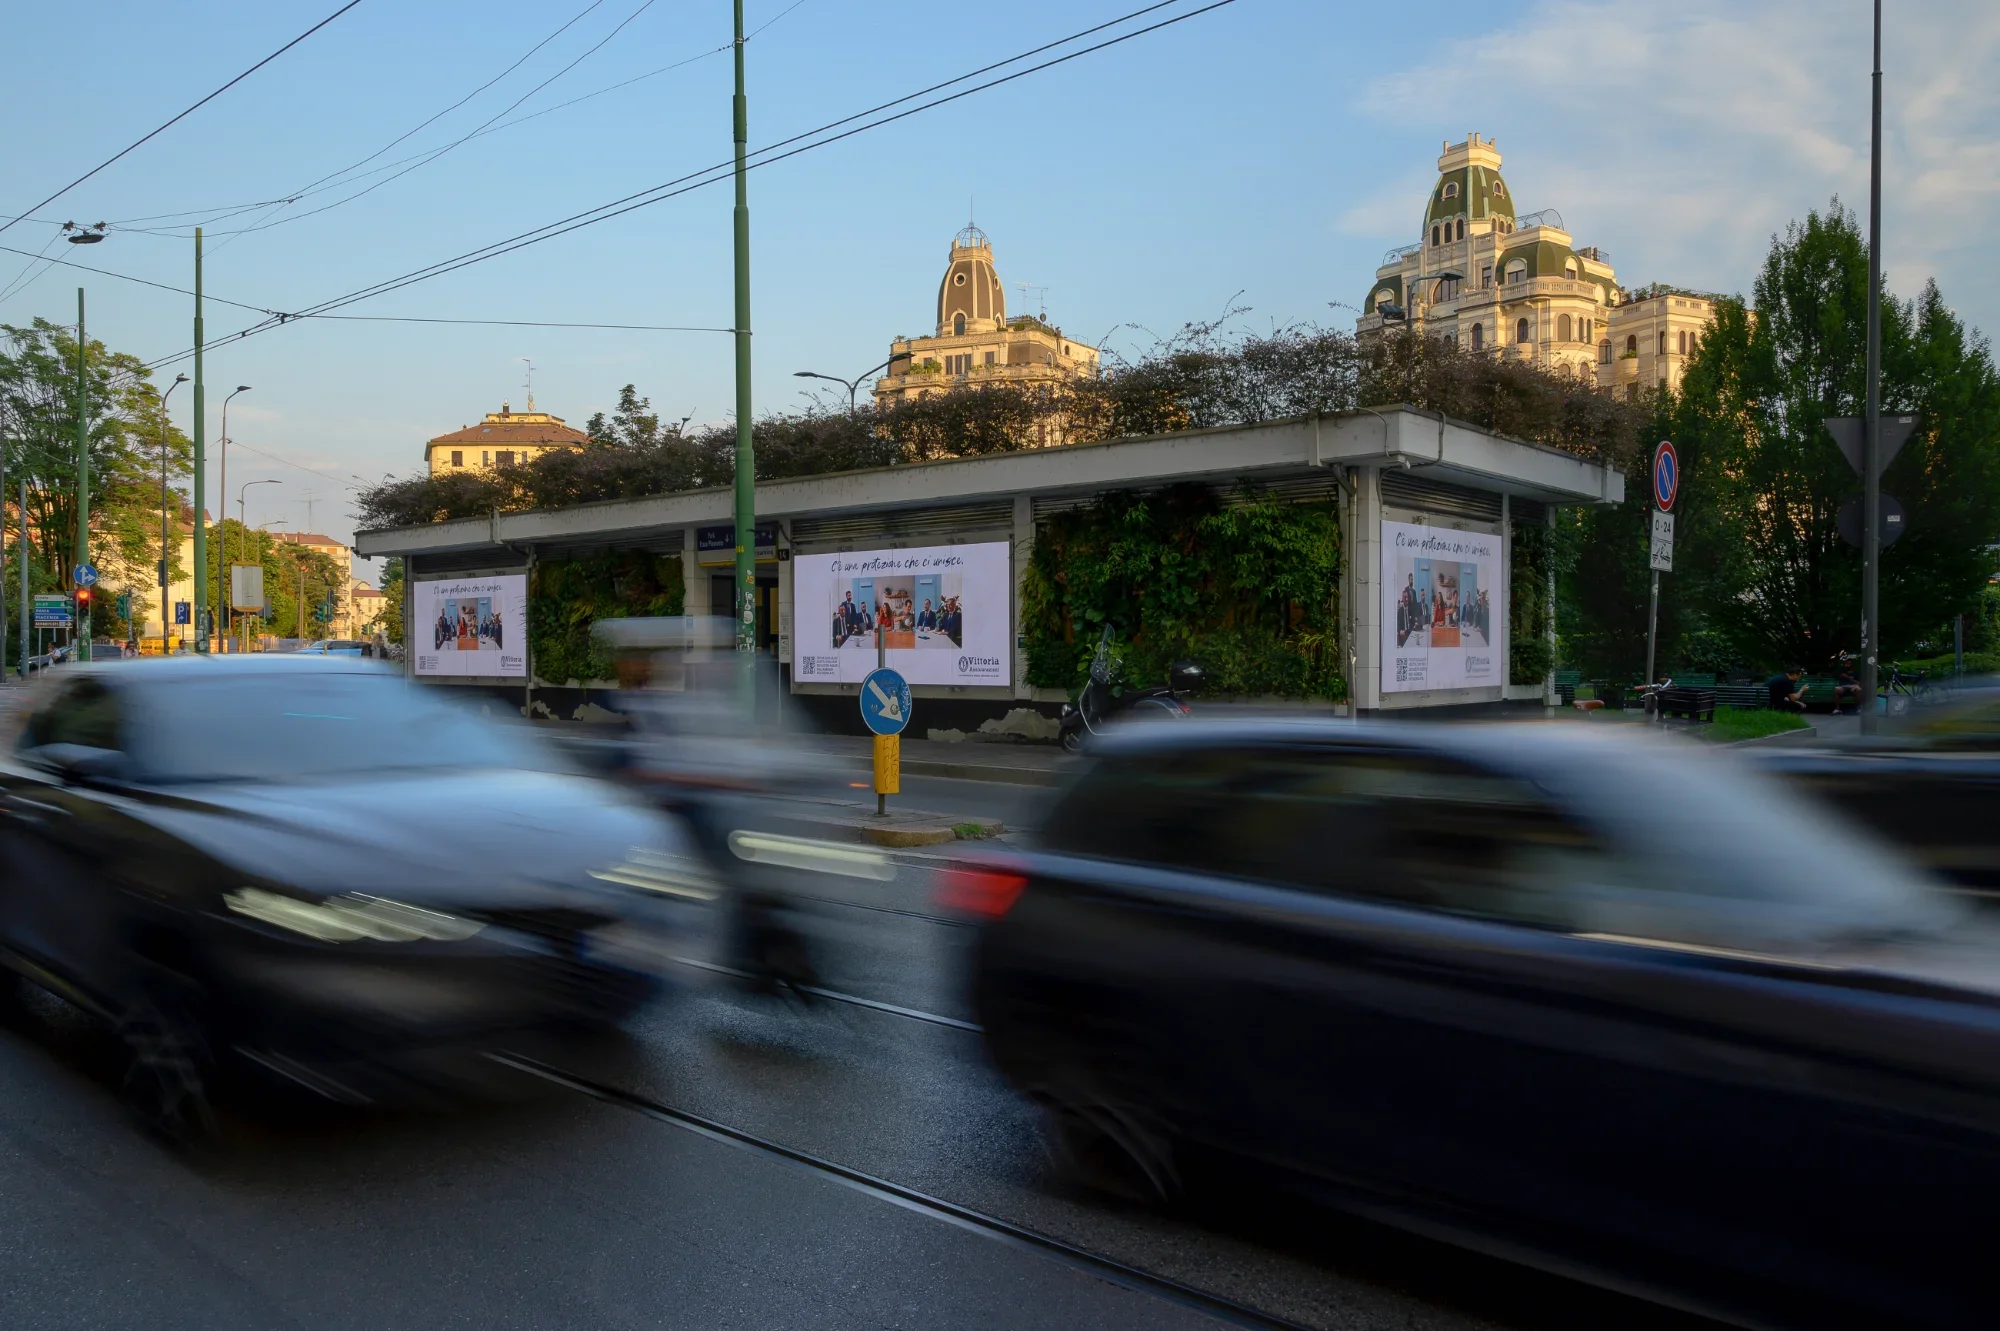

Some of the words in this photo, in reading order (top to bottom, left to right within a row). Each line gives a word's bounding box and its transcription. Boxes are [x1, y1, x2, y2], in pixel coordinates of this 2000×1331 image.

[844, 563, 859, 571] una
[860, 557, 902, 575] protezione
[904, 556, 919, 568] che
[922, 555, 932, 567] ci
[933, 555, 964, 567] unisce.
[968, 656, 999, 665] Vittoria
